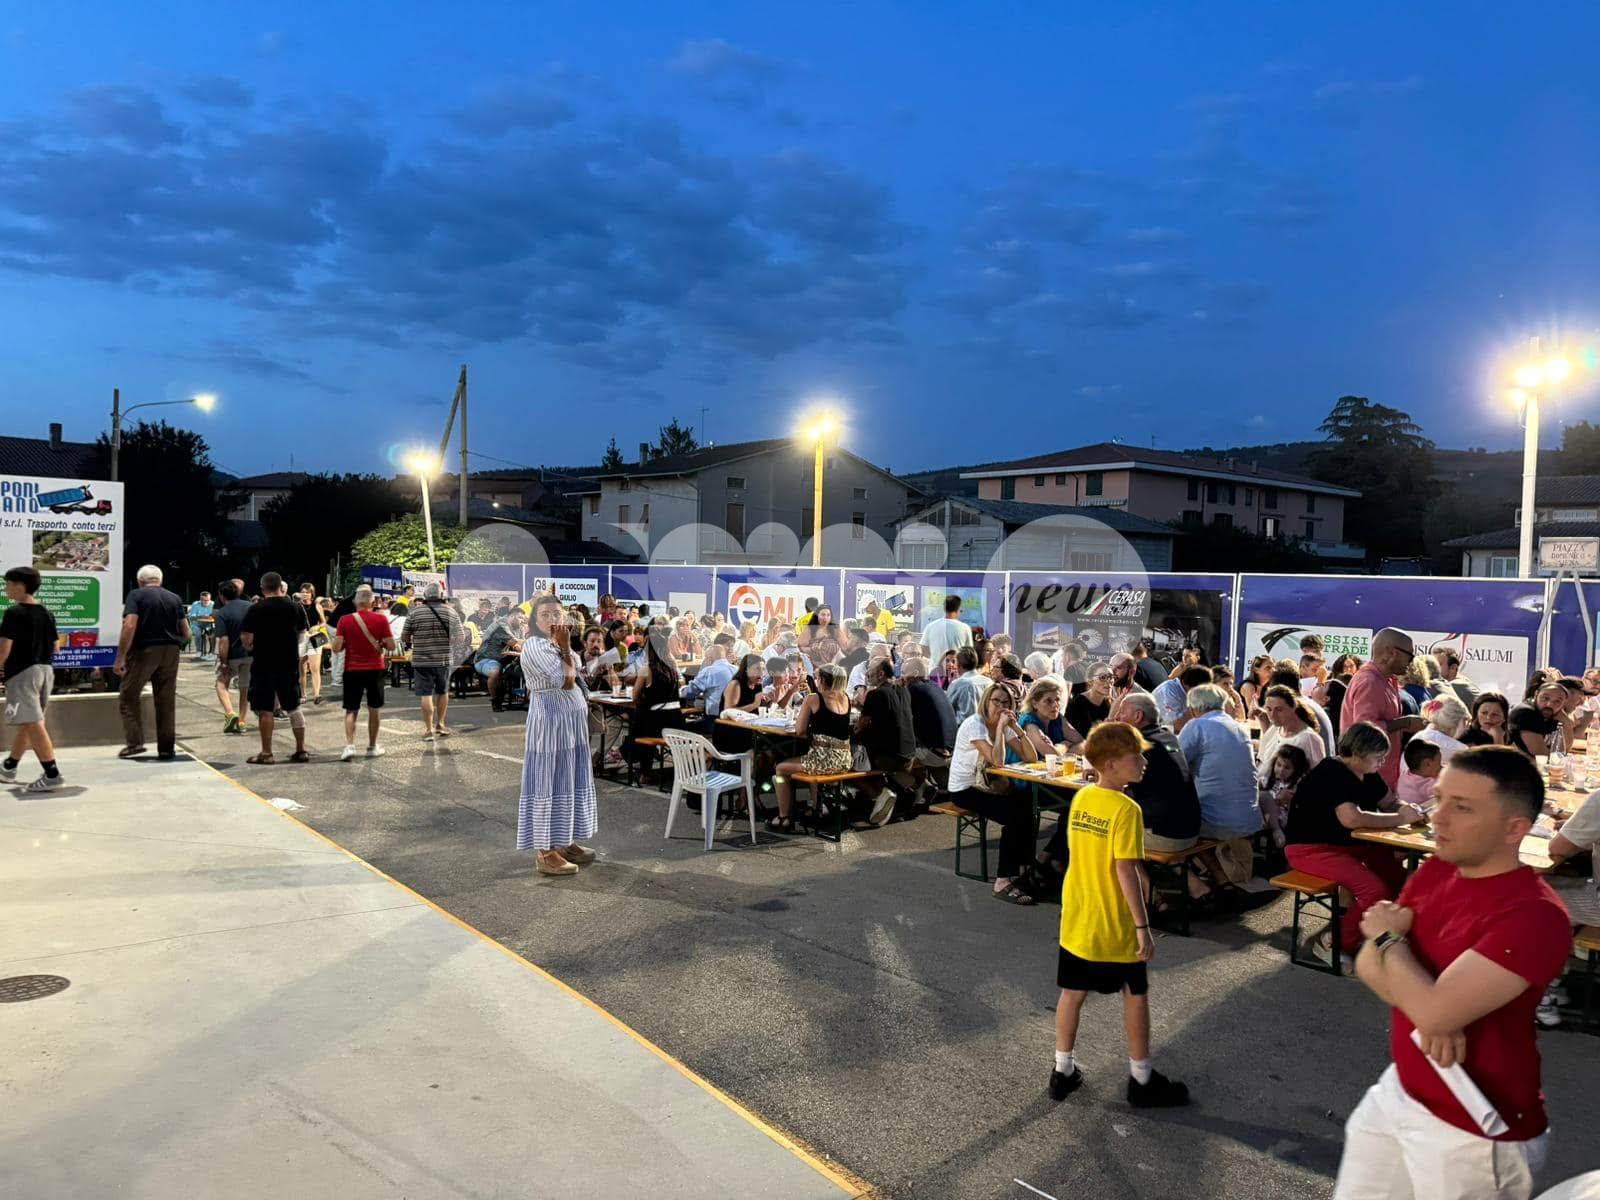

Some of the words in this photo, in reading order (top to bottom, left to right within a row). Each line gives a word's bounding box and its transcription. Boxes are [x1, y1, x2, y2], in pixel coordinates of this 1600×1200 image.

[27, 519, 68, 530] Trasporto
[72, 522, 95, 531] conto
[98, 522, 116, 531] terzi
[535, 579, 547, 590] Q8
[565, 583, 596, 591] CIOCCOLONI
[560, 594, 577, 602] GIULIO
[1109, 590, 1146, 605] CERASA
[1323, 645, 1368, 656] TRADE
[1465, 648, 1513, 664] SALUMI
